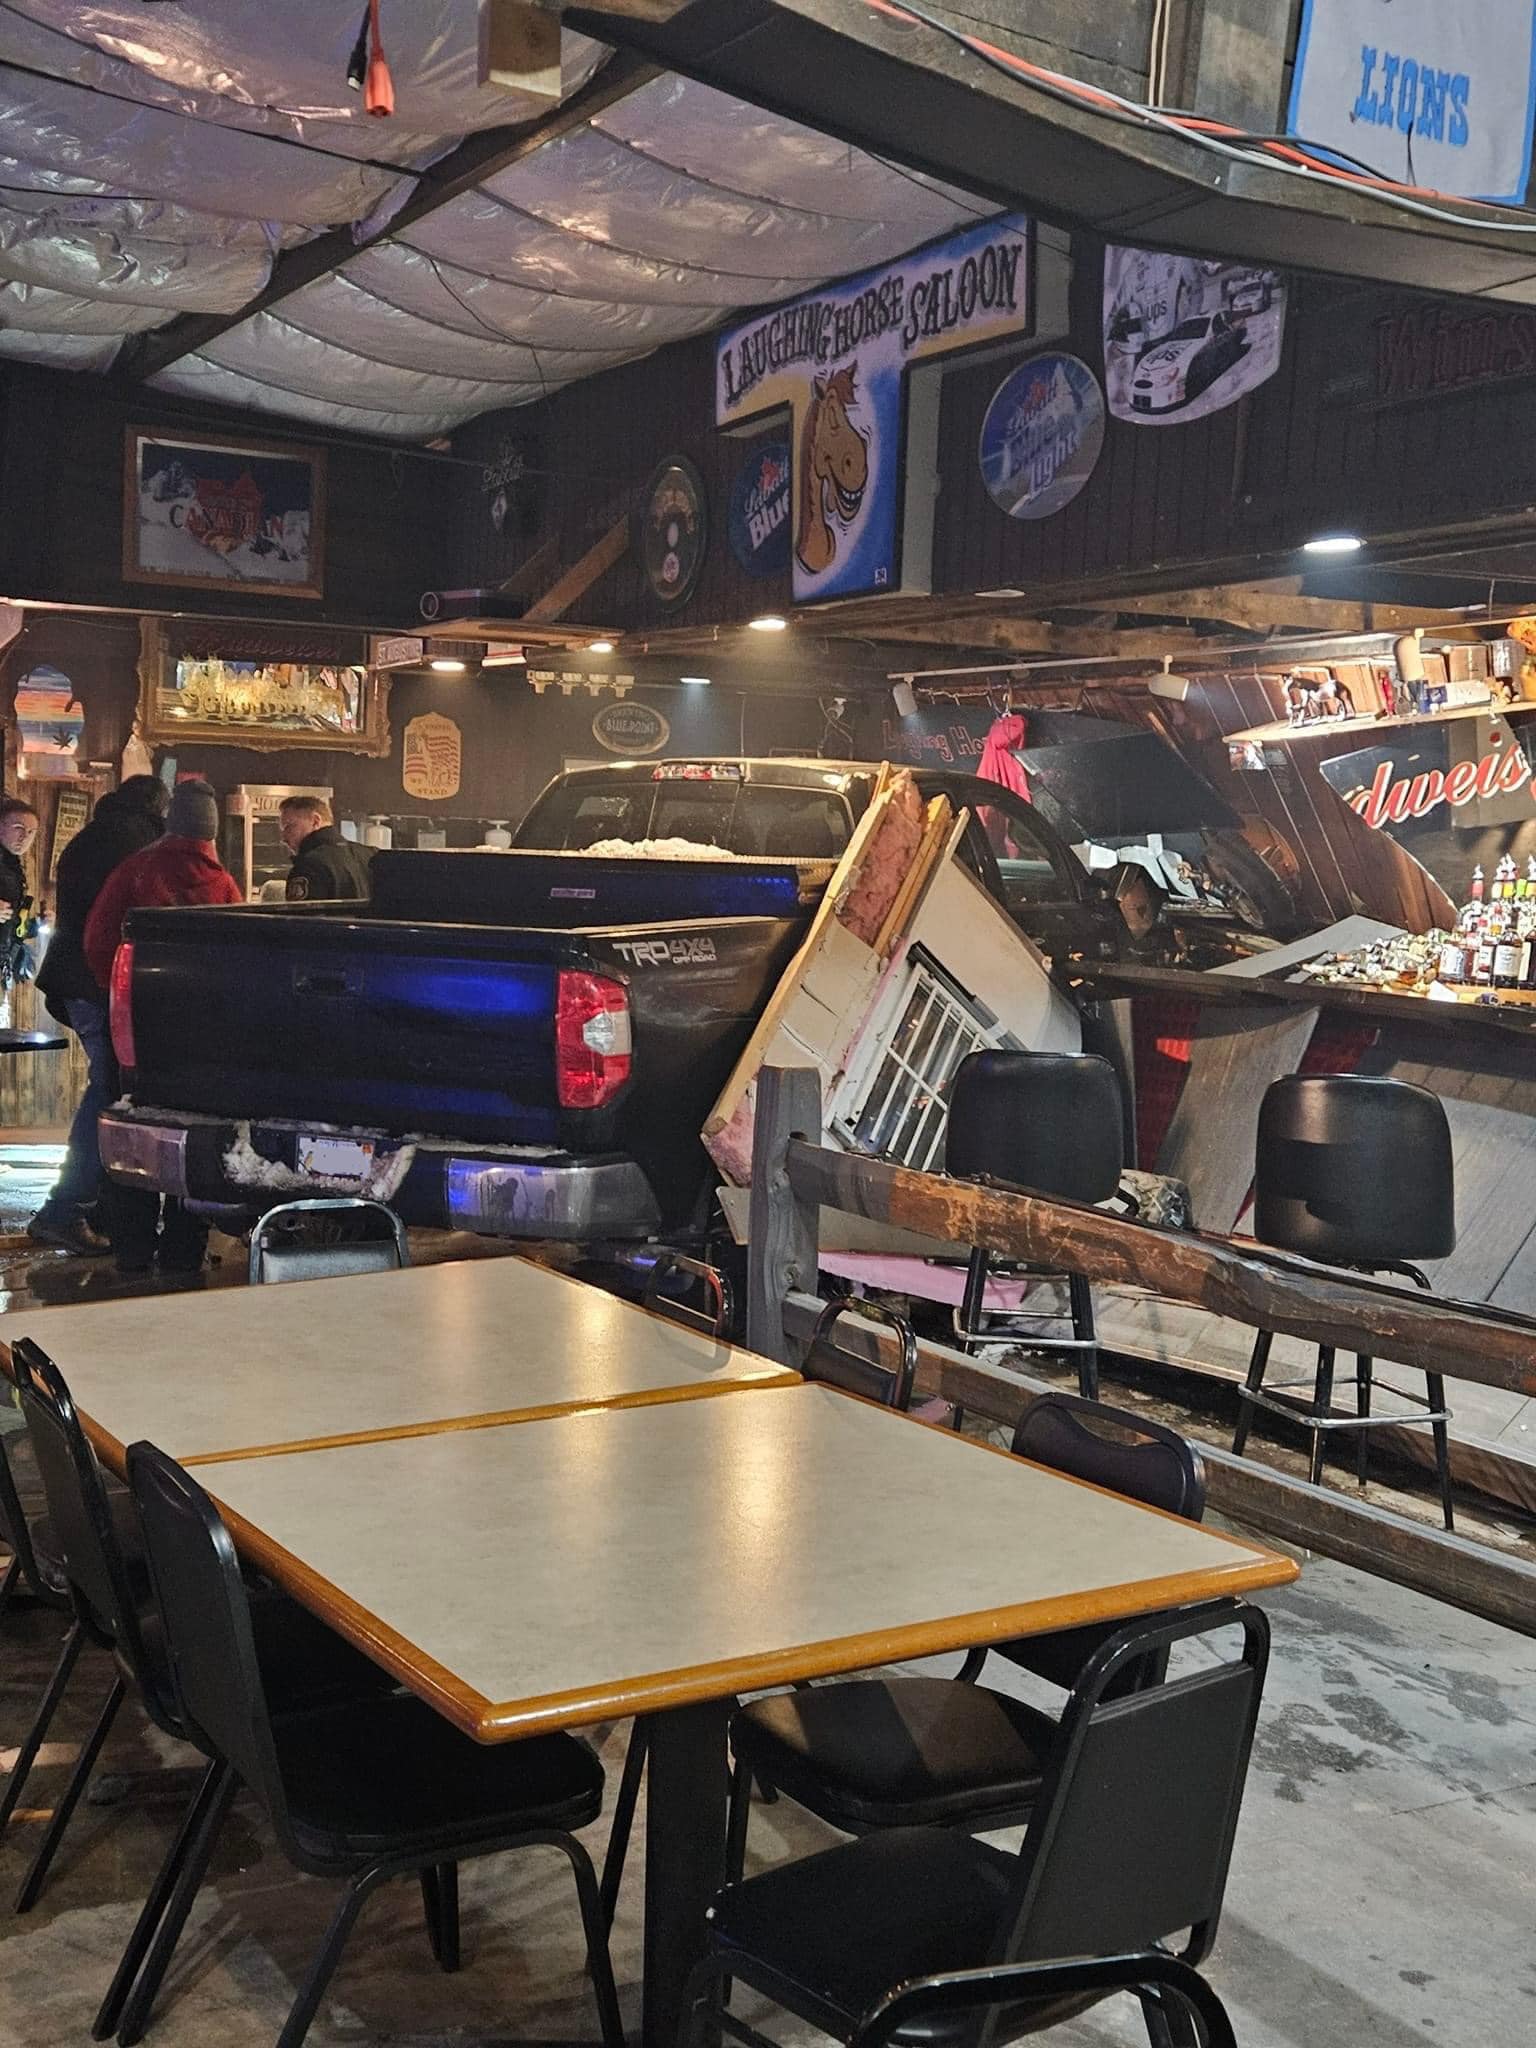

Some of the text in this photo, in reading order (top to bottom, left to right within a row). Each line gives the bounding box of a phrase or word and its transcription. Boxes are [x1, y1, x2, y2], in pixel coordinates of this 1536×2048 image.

[1355, 44, 1470, 148] LIONS
[722, 245, 1023, 404] LAUGHING HORSE SALOON
[1146, 300, 1168, 324] ups
[612, 940, 671, 967] TRD
[672, 953, 717, 965] OFF ROAD
